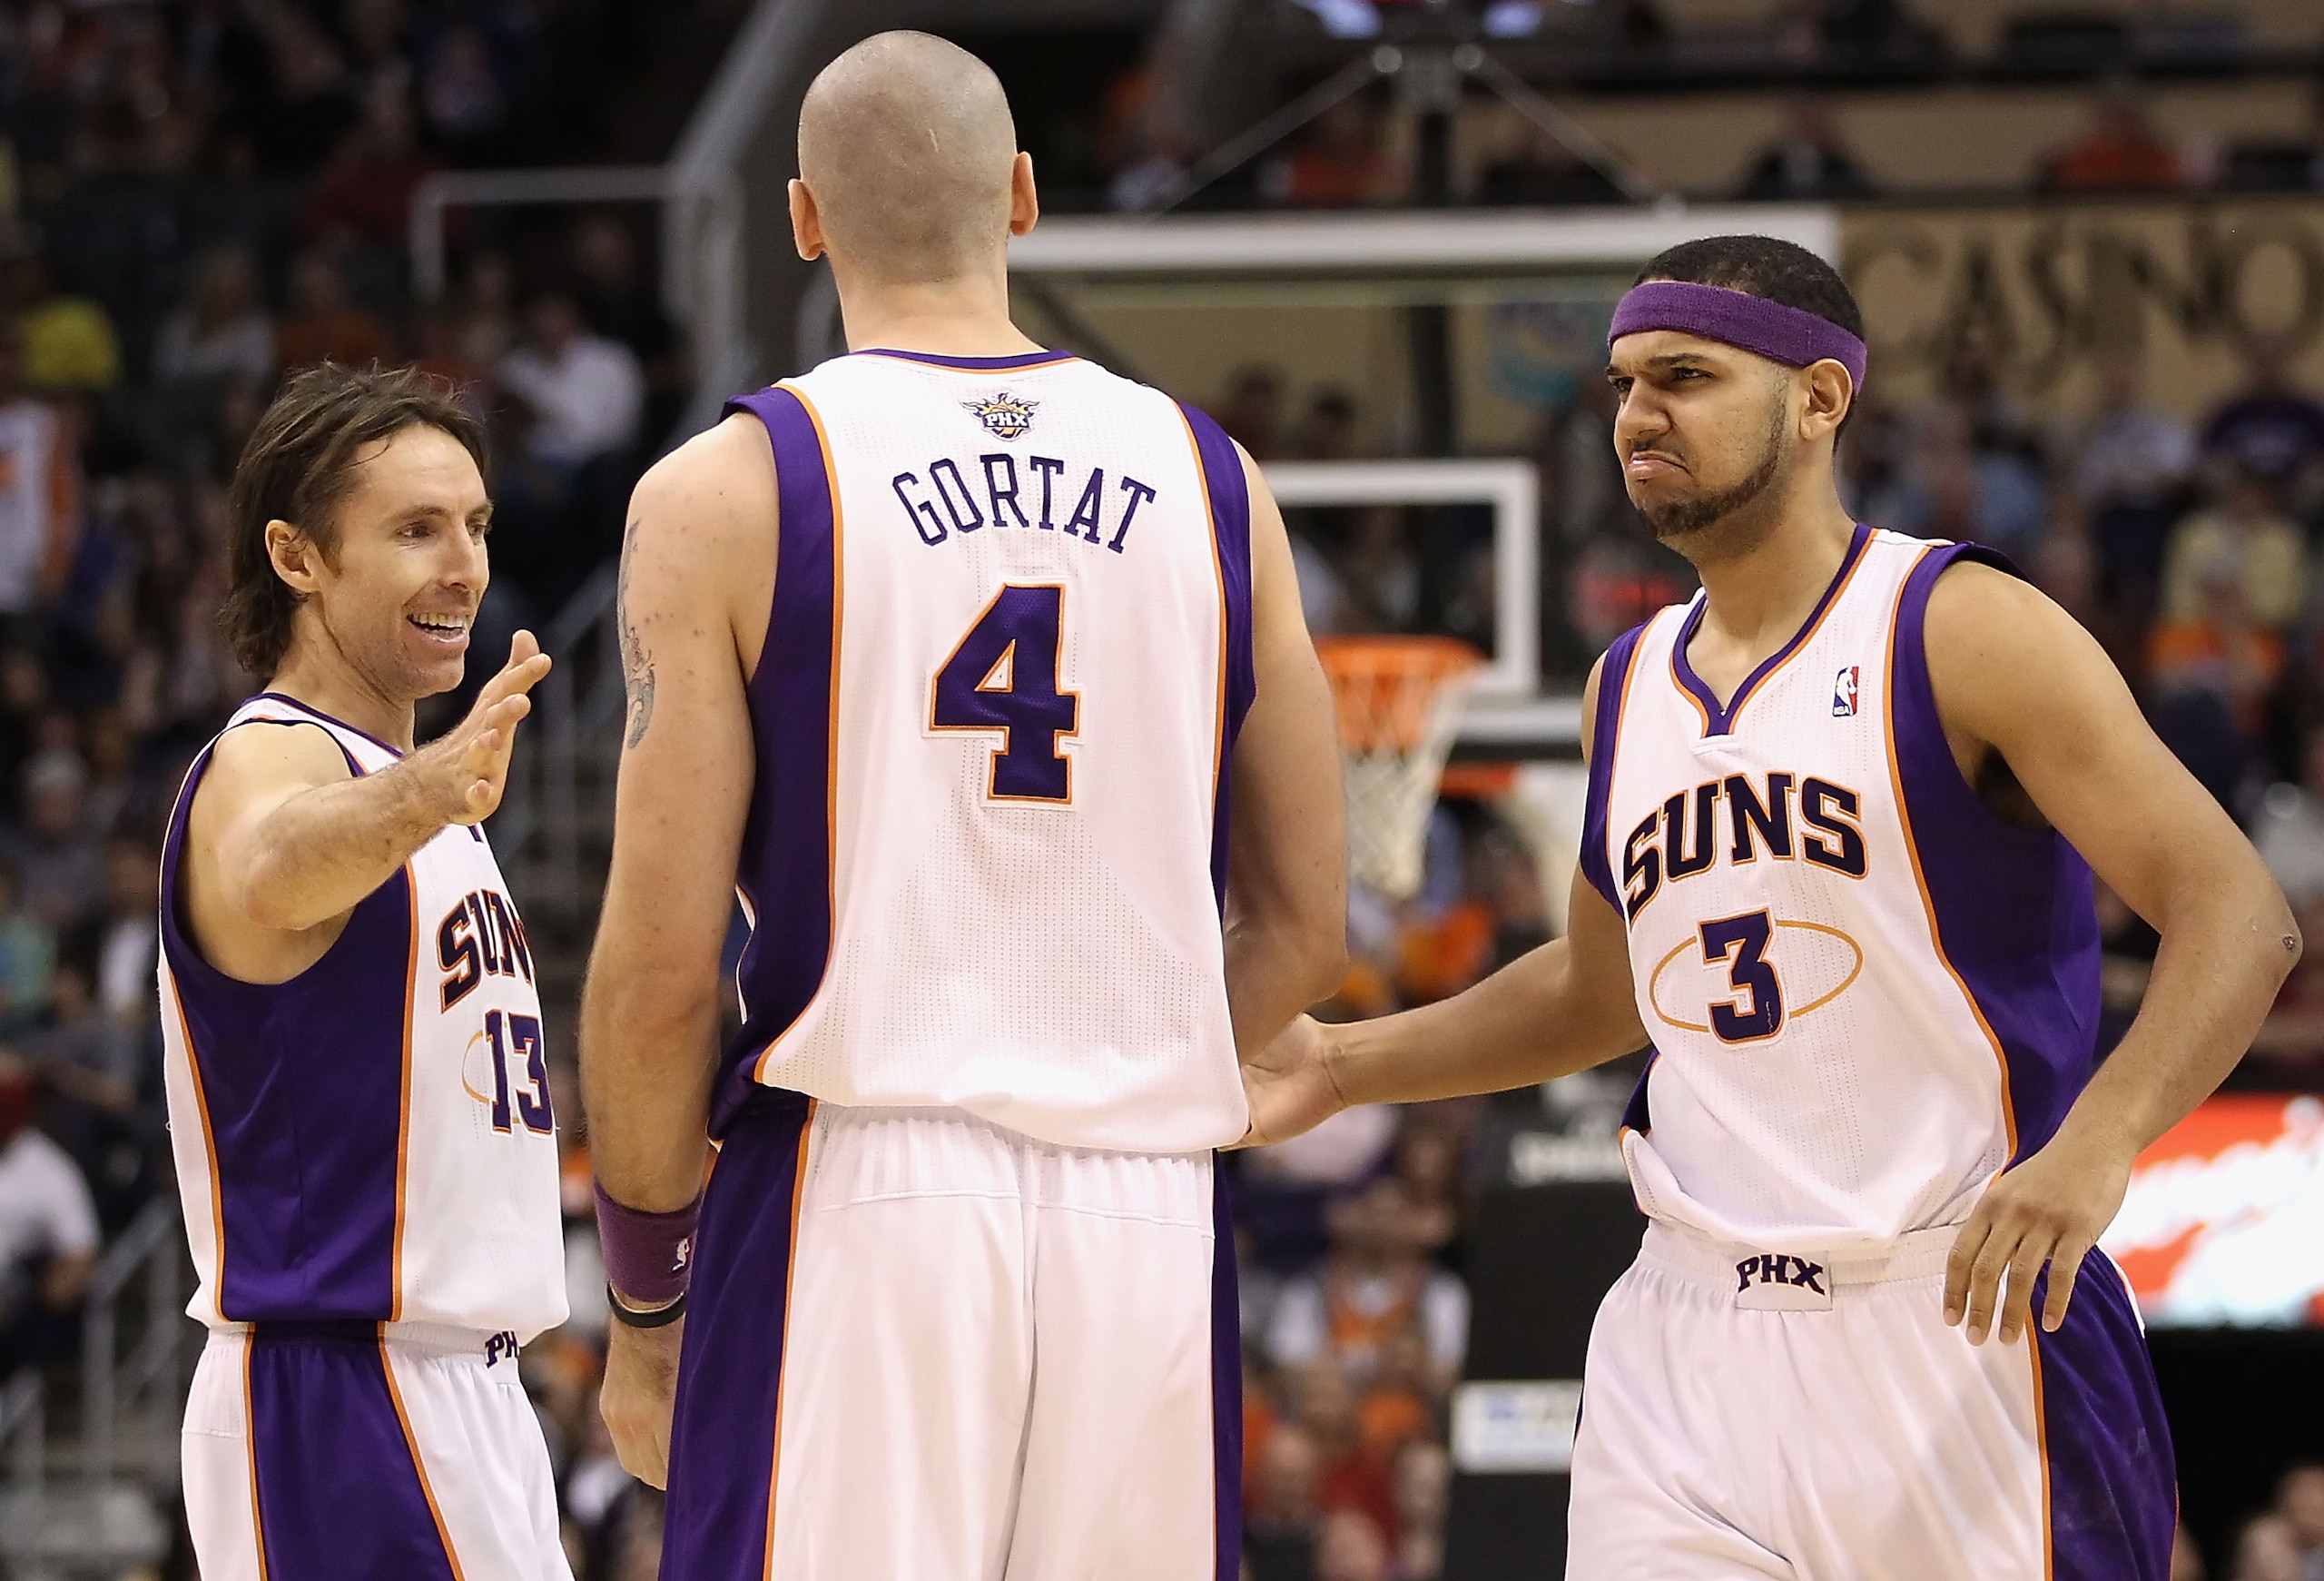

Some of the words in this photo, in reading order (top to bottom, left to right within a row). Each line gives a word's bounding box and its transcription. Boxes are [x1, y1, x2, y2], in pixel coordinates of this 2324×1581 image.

[984, 411, 1029, 427] PHX
[892, 453, 1157, 554] GORTAT
[929, 582, 1081, 805] 4
[1623, 770, 1869, 933] SUNS
[436, 888, 537, 1014] SUN
[1698, 907, 1784, 1044] 3
[485, 1008, 553, 1134] 13
[1736, 1254, 1826, 1296] PHX
[485, 1330, 517, 1369] PH
